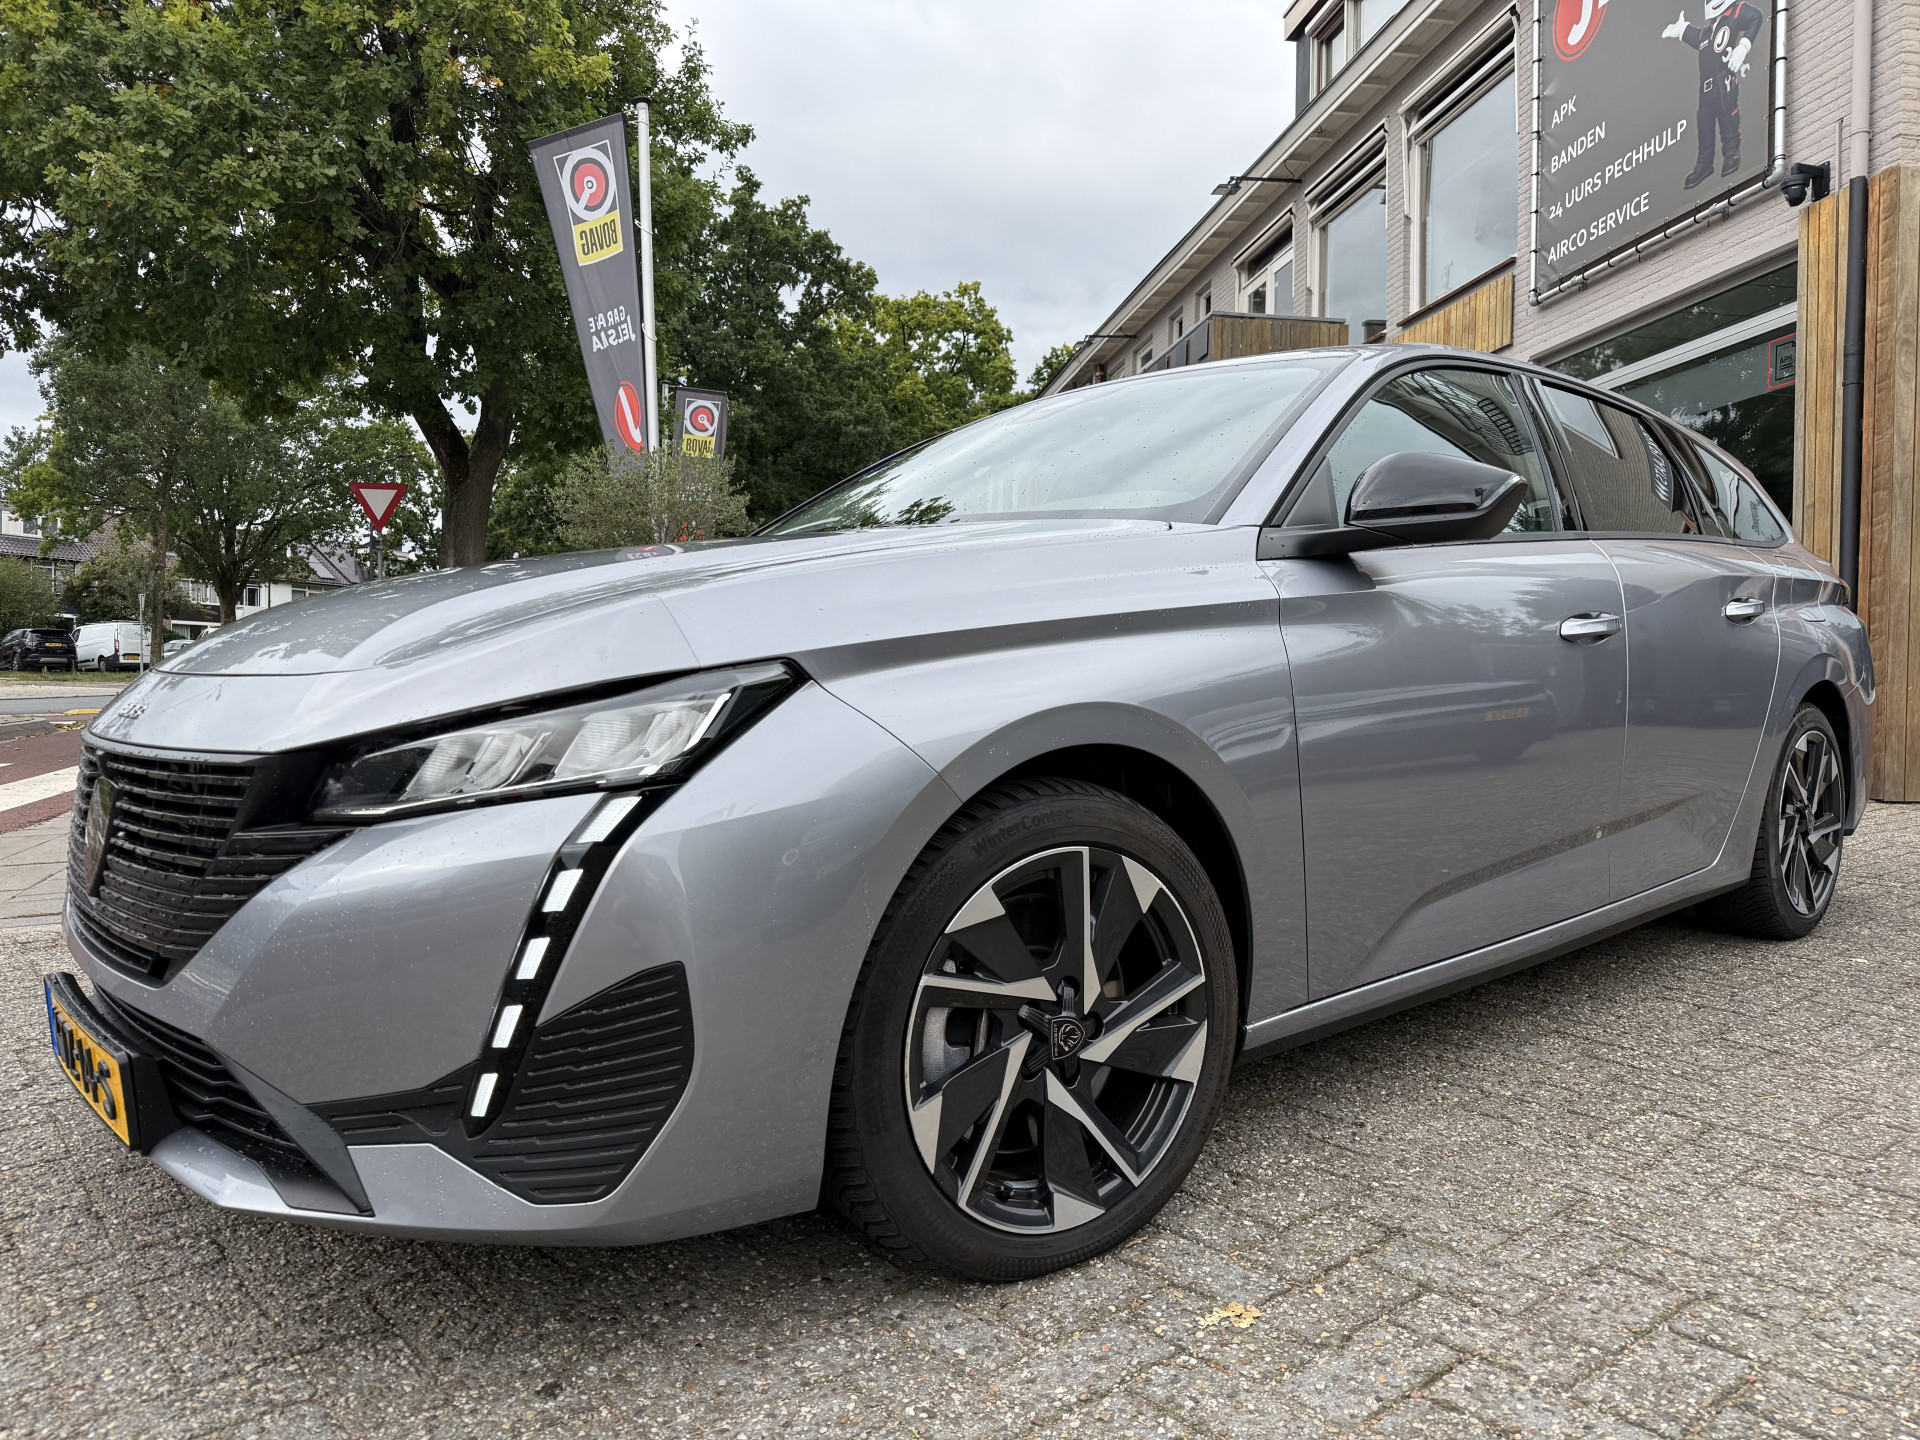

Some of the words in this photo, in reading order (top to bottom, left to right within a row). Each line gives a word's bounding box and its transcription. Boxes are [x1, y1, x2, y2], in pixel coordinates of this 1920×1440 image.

[1551, 95, 1577, 128] APK
[1549, 203, 1563, 220] 24
[1565, 176, 1602, 209] UURS
[1605, 118, 1687, 185] PECHHULP
[1551, 120, 1607, 174] BANDEN
[1547, 227, 1587, 265] AIRCO
[1589, 192, 1650, 241] SERVICE
[1779, 354, 1793, 365] APK
